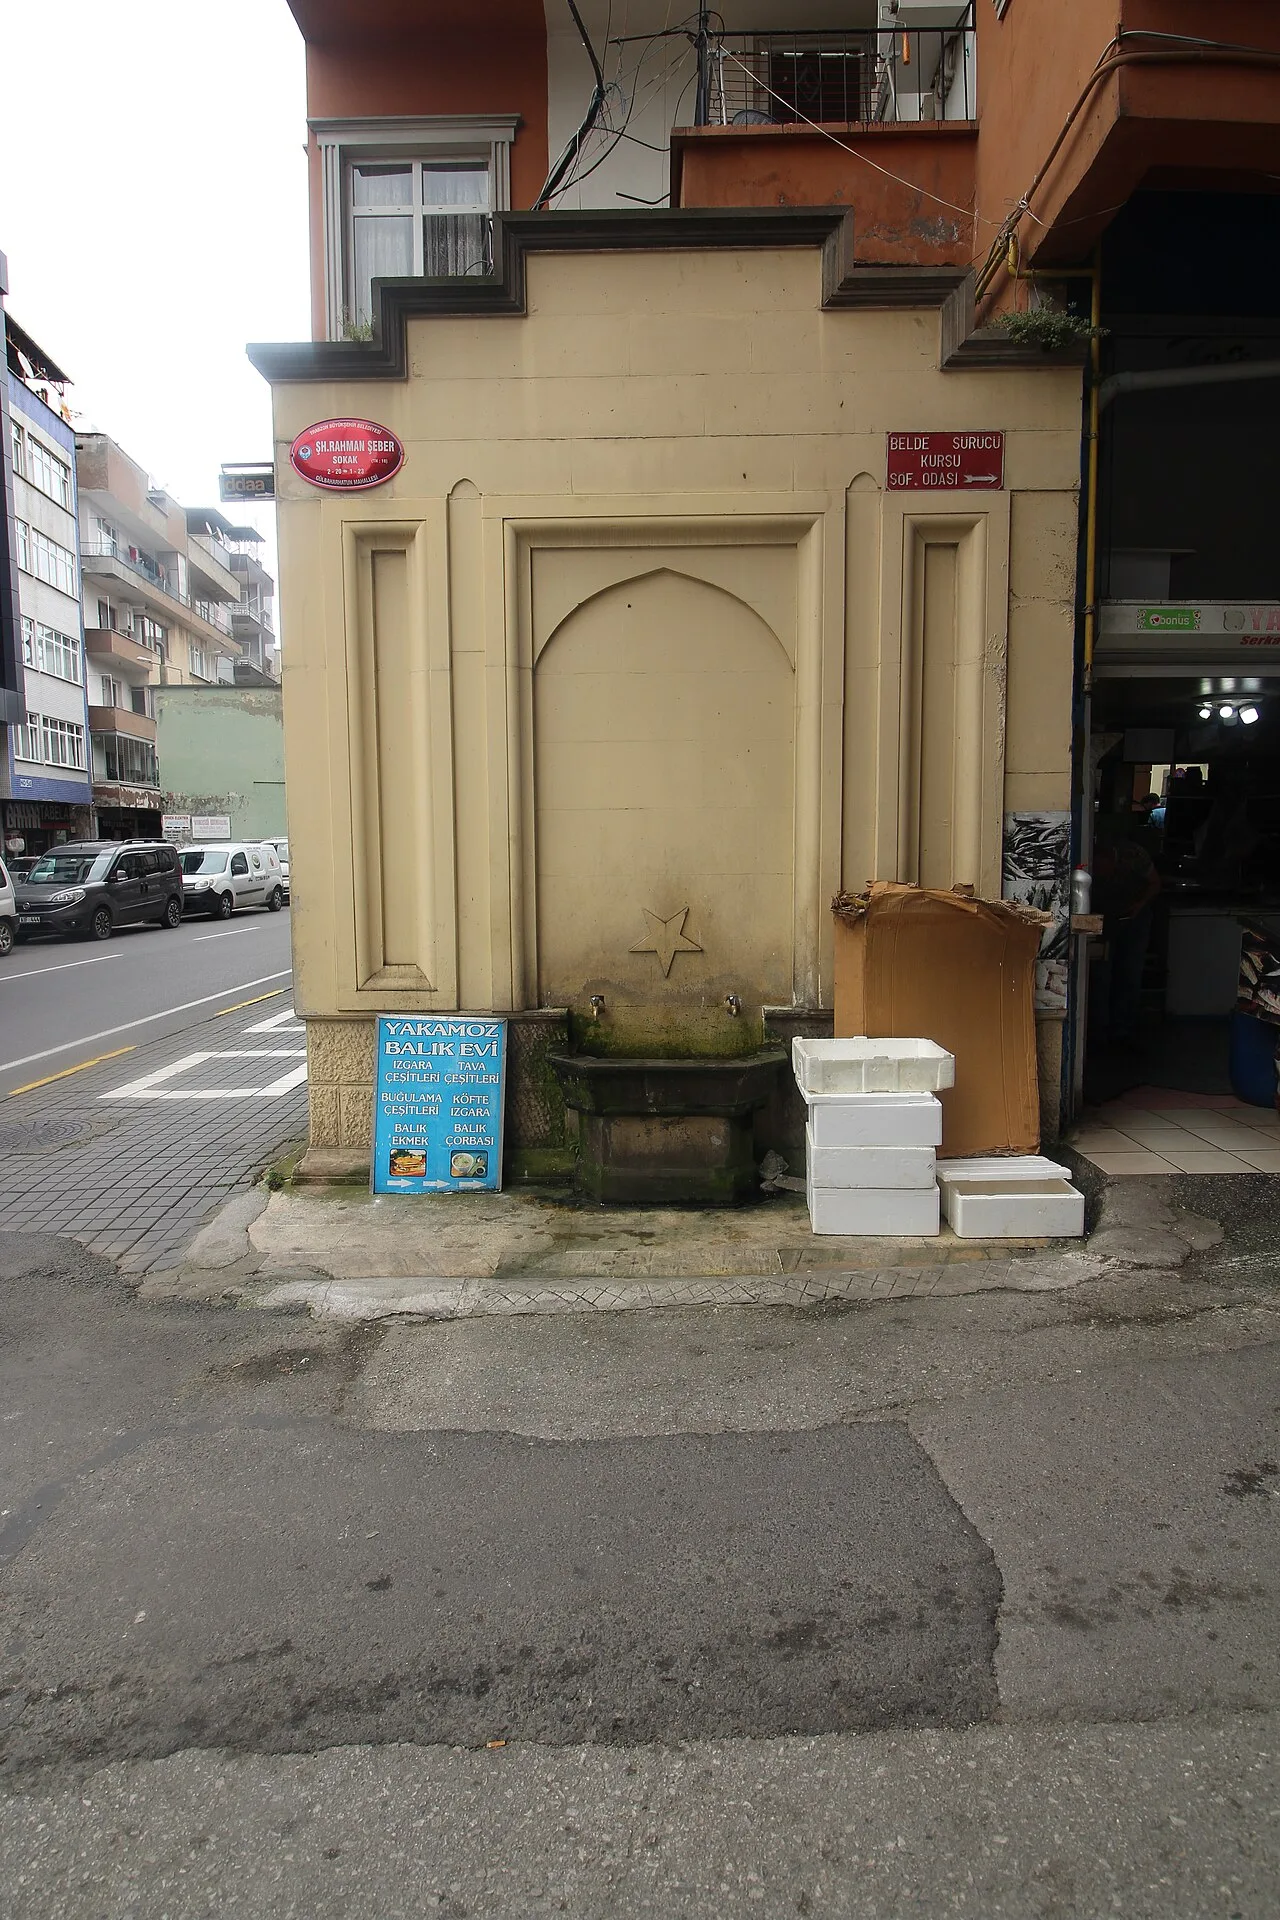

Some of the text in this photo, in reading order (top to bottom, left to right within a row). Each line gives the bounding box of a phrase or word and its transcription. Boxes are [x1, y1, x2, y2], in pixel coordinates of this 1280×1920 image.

[316, 441, 394, 455] ŞH.RAHMAN ŞEBER
[890, 436, 1000, 450] BELDE SÜRÜCÜ
[332, 456, 358, 464] SOKAK
[921, 454, 961, 468] KURSU
[922, 472, 958, 486] ODASI
[1160, 615, 1190, 625] bonus
[385, 1022, 499, 1038] YAKAMOZ
[384, 1041, 498, 1057] BALIK EVİ
[394, 1060, 432, 1070] IZGARA
[458, 1062, 486, 1070] TAVA
[386, 1072, 440, 1084] ÇEŞİTLERİ
[444, 1072, 499, 1085] ÇEŞİTLERİ
[382, 1092, 442, 1102] BUĞULAMA
[453, 1093, 489, 1104] KÖFTE
[384, 1104, 439, 1116] ÇEŞİTLERİ
[450, 1108, 490, 1116] IZGARA
[394, 1124, 427, 1133] BALIK
[454, 1124, 486, 1133] BALIK
[392, 1137, 428, 1146] EKMEK
[446, 1136, 494, 1147] ÇORBASI
